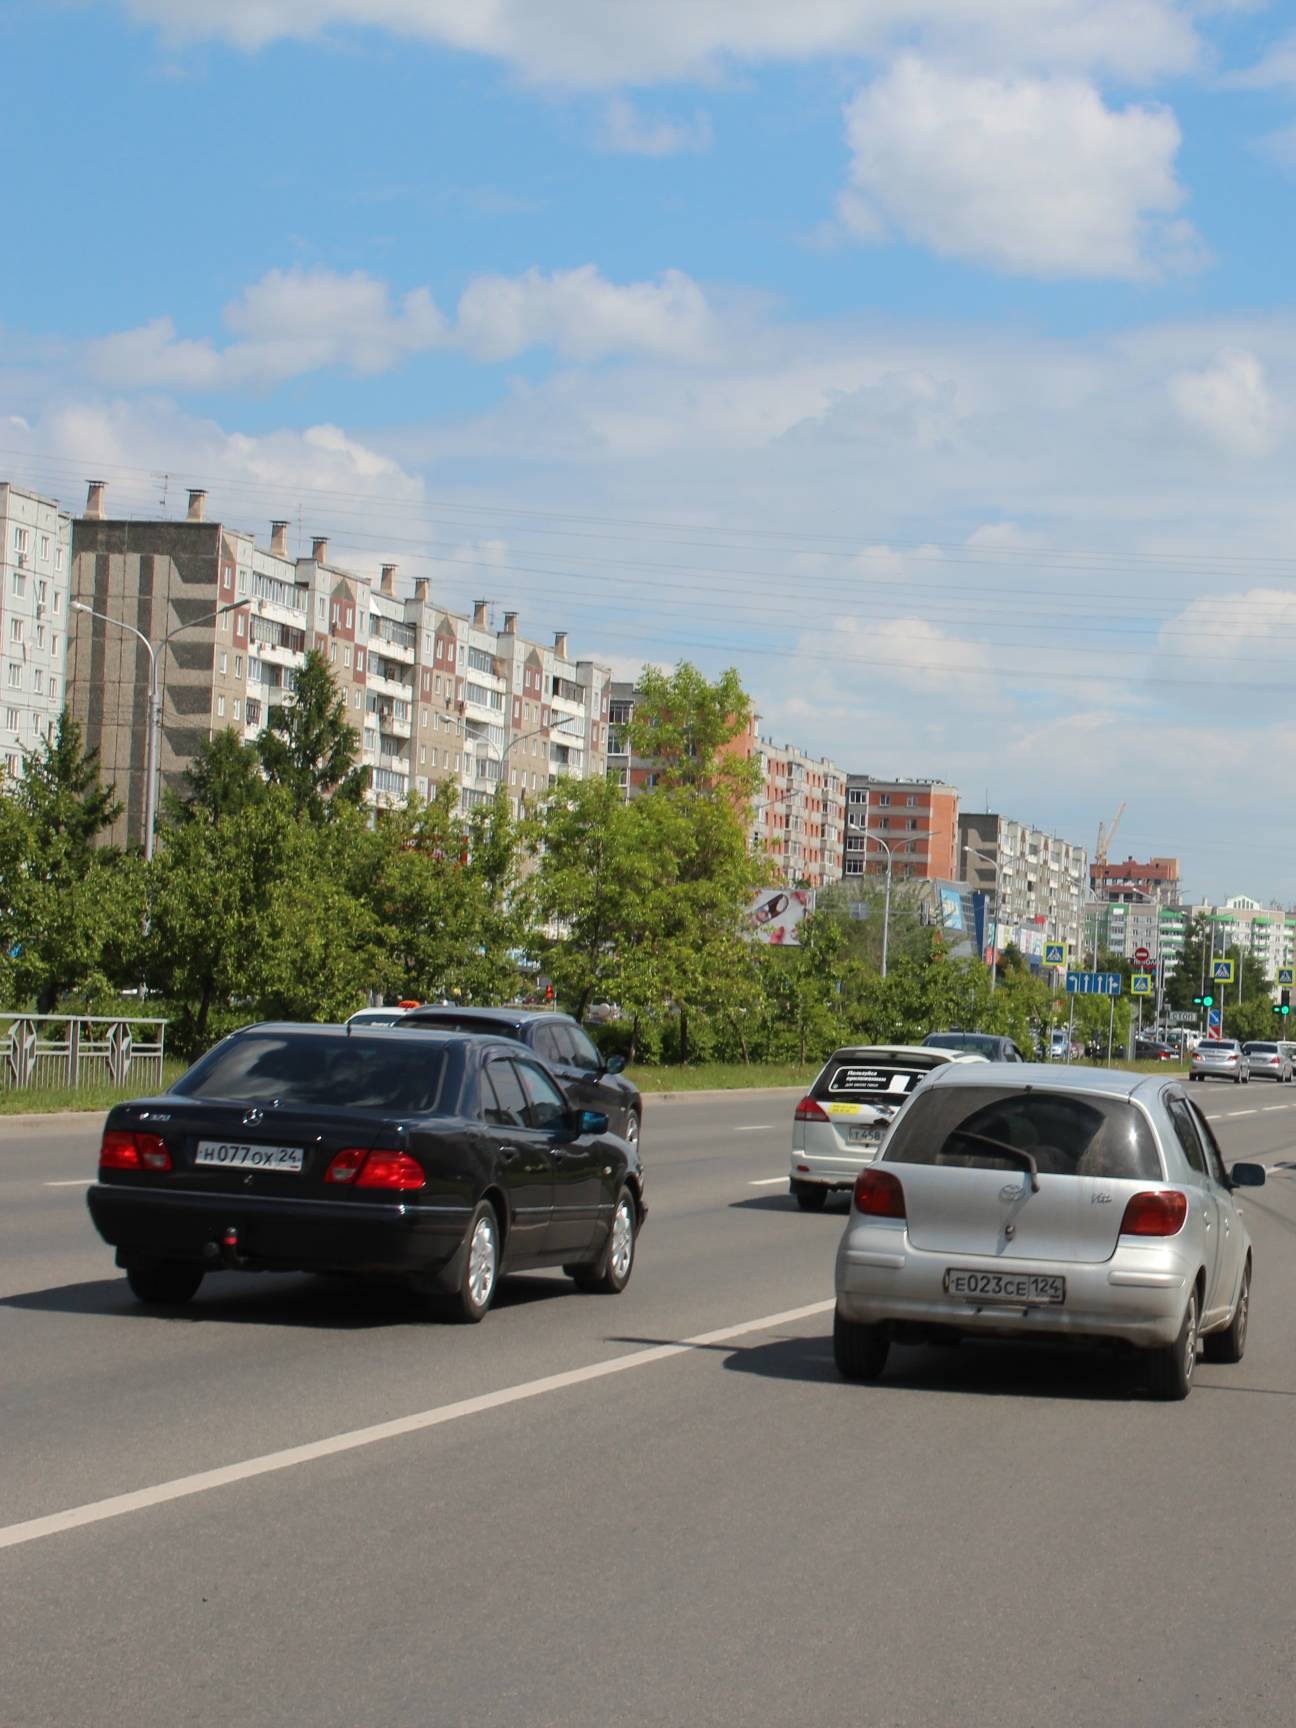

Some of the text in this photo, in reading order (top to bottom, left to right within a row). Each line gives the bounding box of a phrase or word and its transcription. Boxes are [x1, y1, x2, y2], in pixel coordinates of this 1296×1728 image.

[203, 1145, 297, 1165] Н077ОХ 24
[955, 1275, 1059, 1296] Е023СЕ 124
